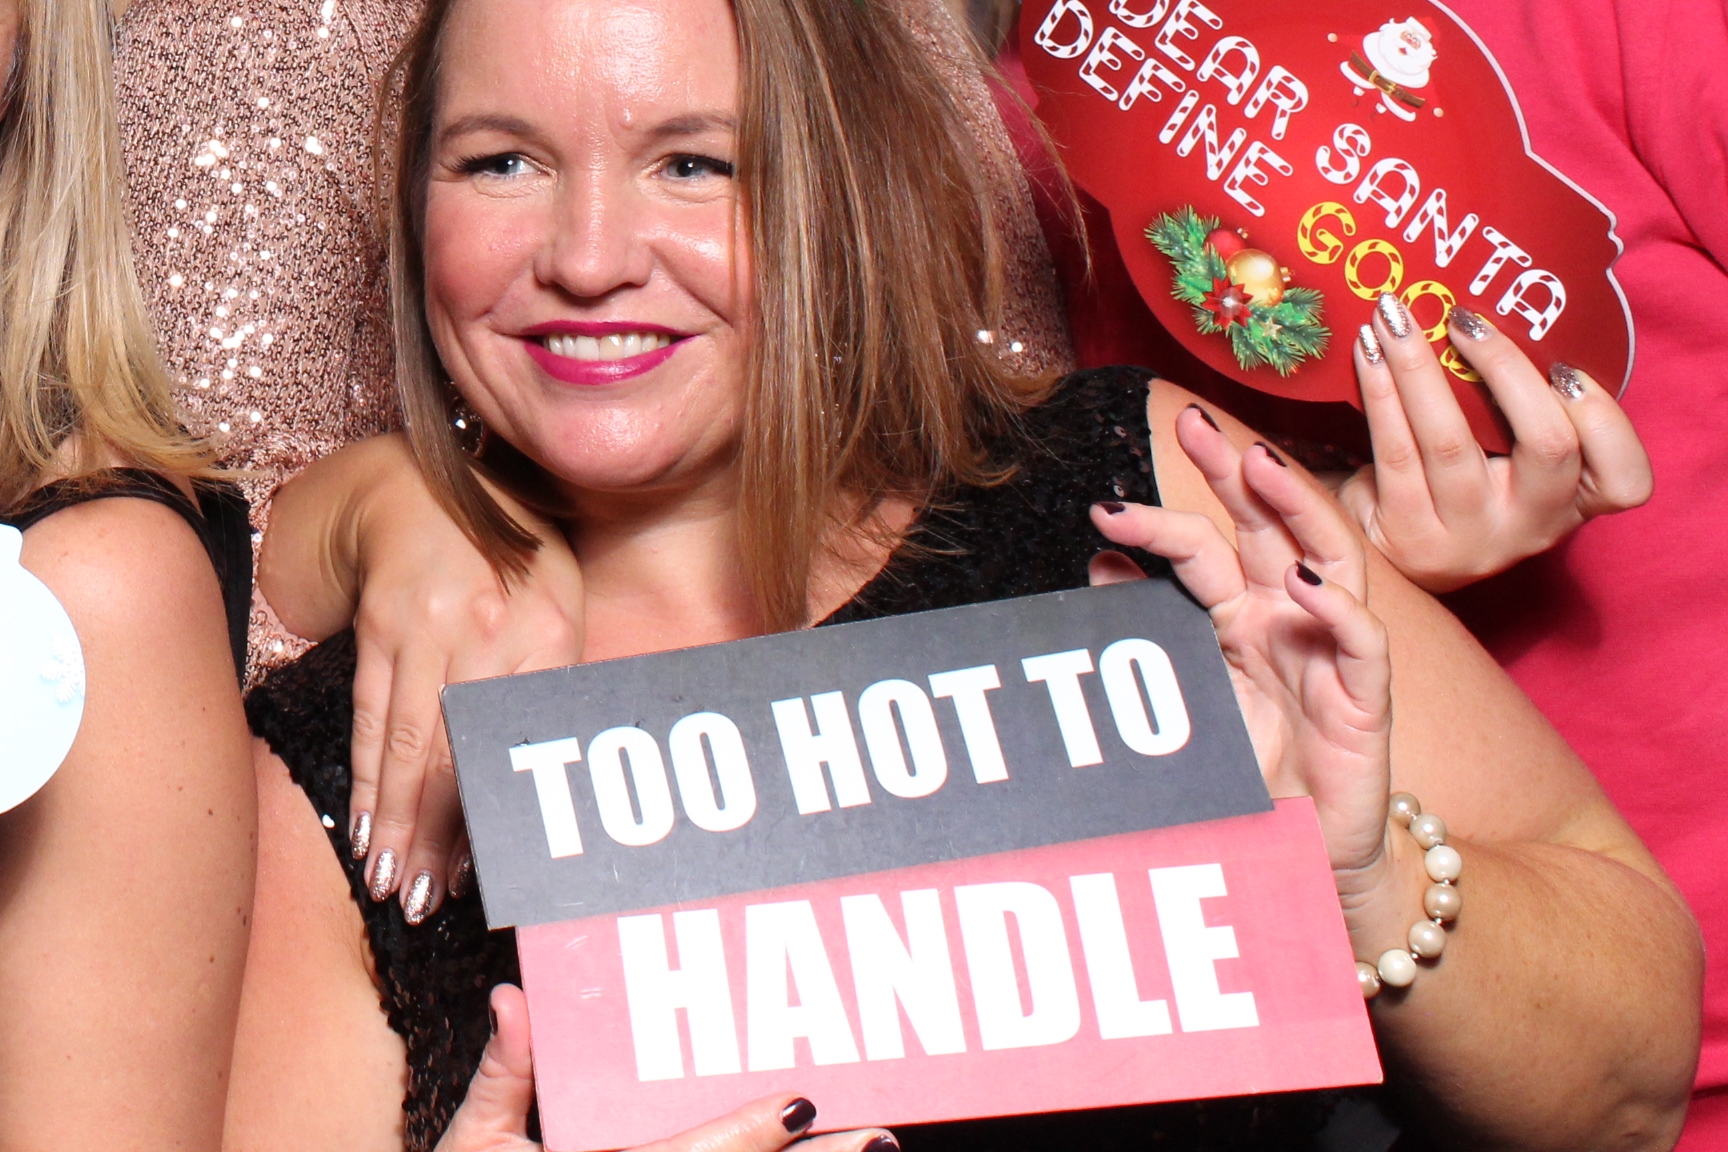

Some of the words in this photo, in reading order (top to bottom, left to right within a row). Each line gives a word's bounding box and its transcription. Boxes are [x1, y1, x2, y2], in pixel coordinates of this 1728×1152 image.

[1315, 123, 1567, 341] SANTA
[509, 710, 758, 860] TOO
[771, 663, 1010, 816] HOT
[1021, 637, 1193, 768] TO
[616, 862, 1261, 1083] HANDLE
